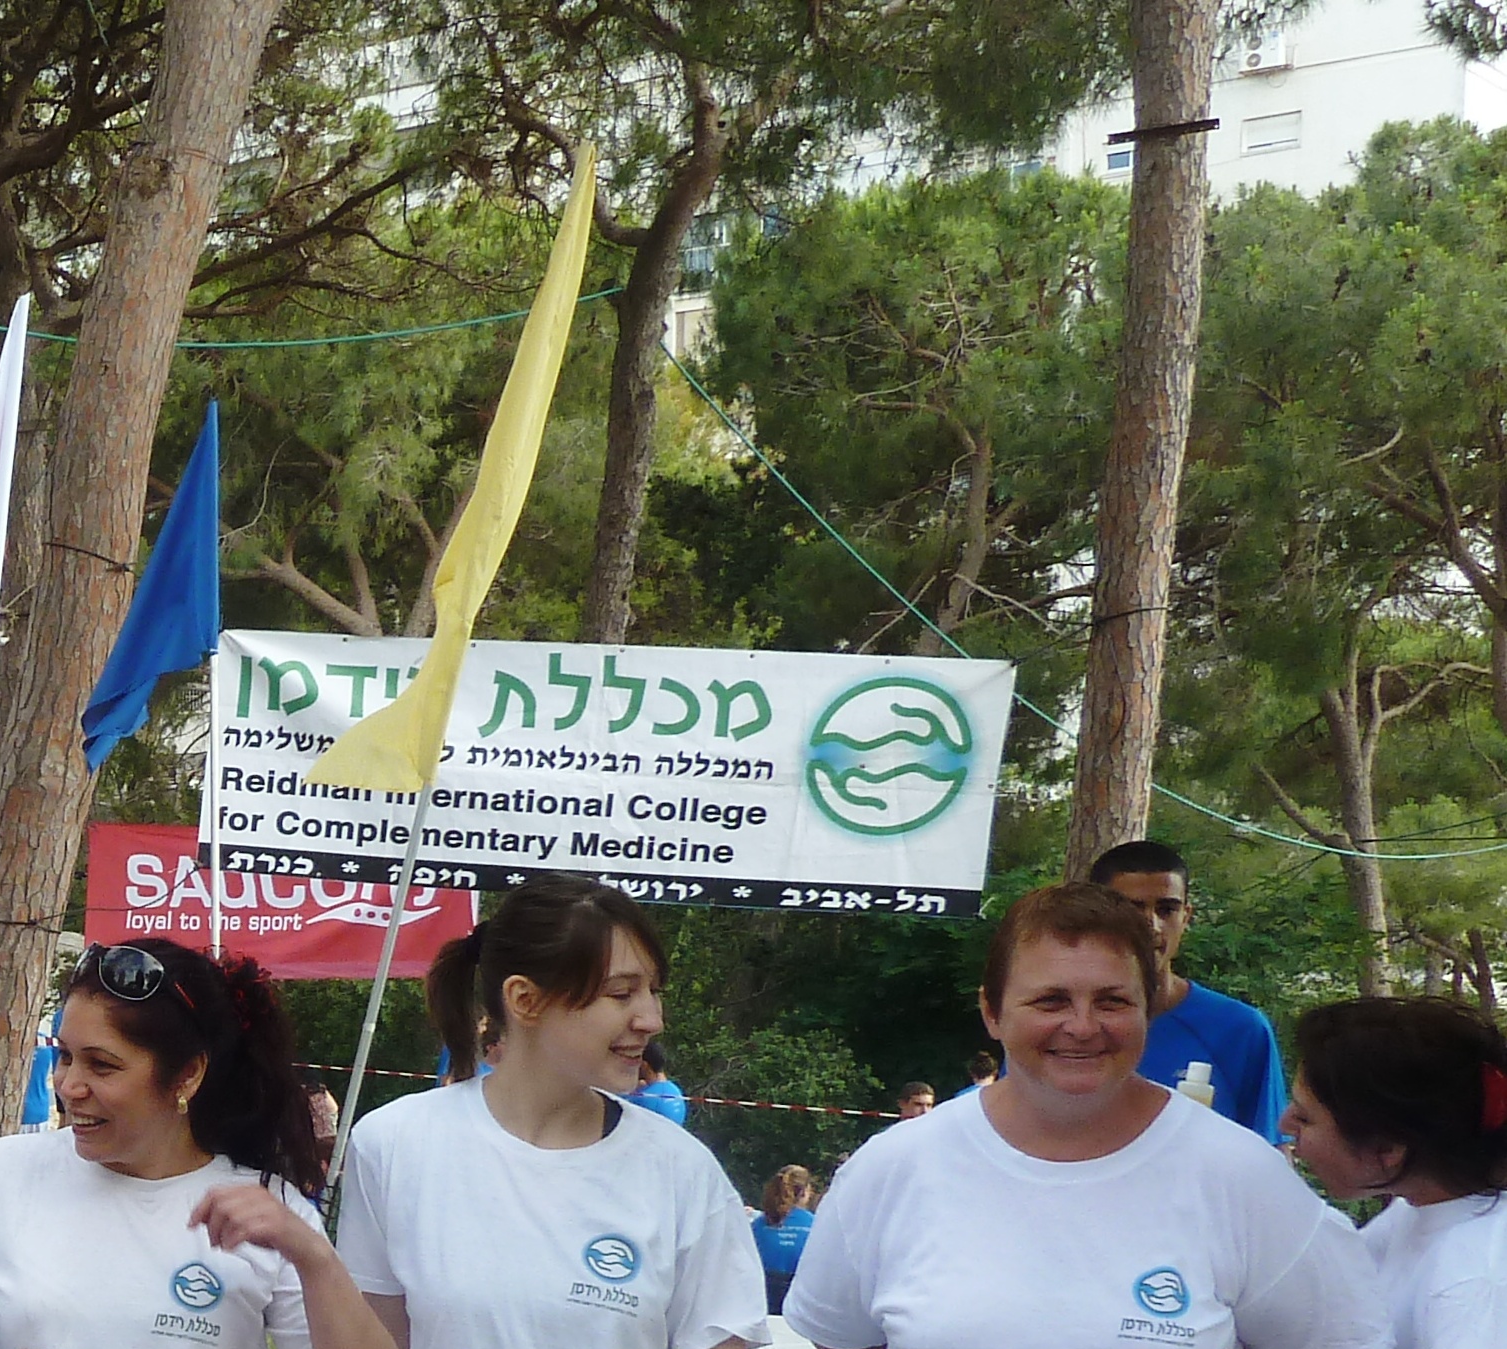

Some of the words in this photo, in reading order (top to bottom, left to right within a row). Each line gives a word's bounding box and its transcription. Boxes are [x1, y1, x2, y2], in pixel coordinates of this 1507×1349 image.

[236, 655, 420, 718] ידמן
[477, 652, 772, 742] מכללת
[466, 744, 641, 774] הבינלאומית
[653, 751, 774, 781] המכללה
[627, 794, 767, 829] College
[219, 806, 264, 831] for
[570, 831, 734, 864] Medicine
[778, 887, 947, 914] תל-אביב
[125, 910, 173, 934] loyal
[179, 911, 201, 931] to
[248, 912, 303, 936] sport
